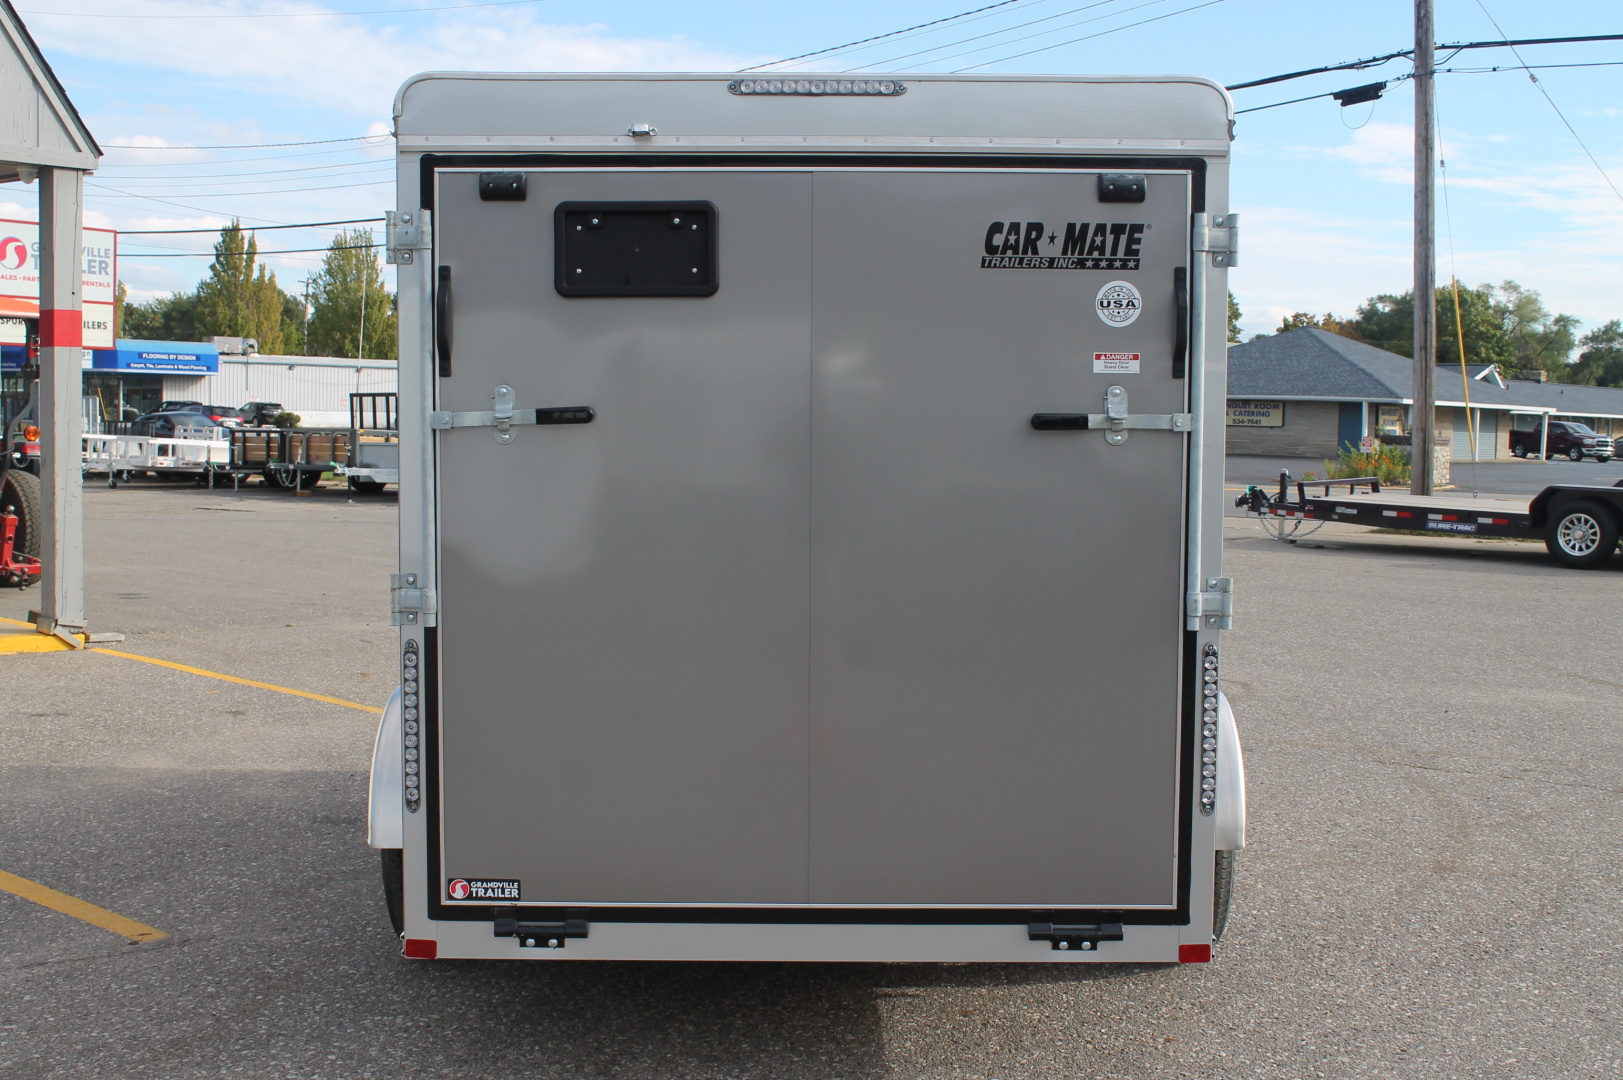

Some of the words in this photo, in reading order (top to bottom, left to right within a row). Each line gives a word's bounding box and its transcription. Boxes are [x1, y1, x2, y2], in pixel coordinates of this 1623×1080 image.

[984, 221, 1044, 256] CAR
[1061, 222, 1145, 257] MATE
[983, 257, 1050, 268] TRAILERS
[1053, 258, 1081, 269] INC.
[1099, 300, 1136, 309] USA
[1233, 410, 1271, 418] CATERING
[1428, 522, 1476, 532] SURE-TRAC
[470, 881, 519, 889] GRANDVILLE
[470, 888, 520, 898] TRAILER
